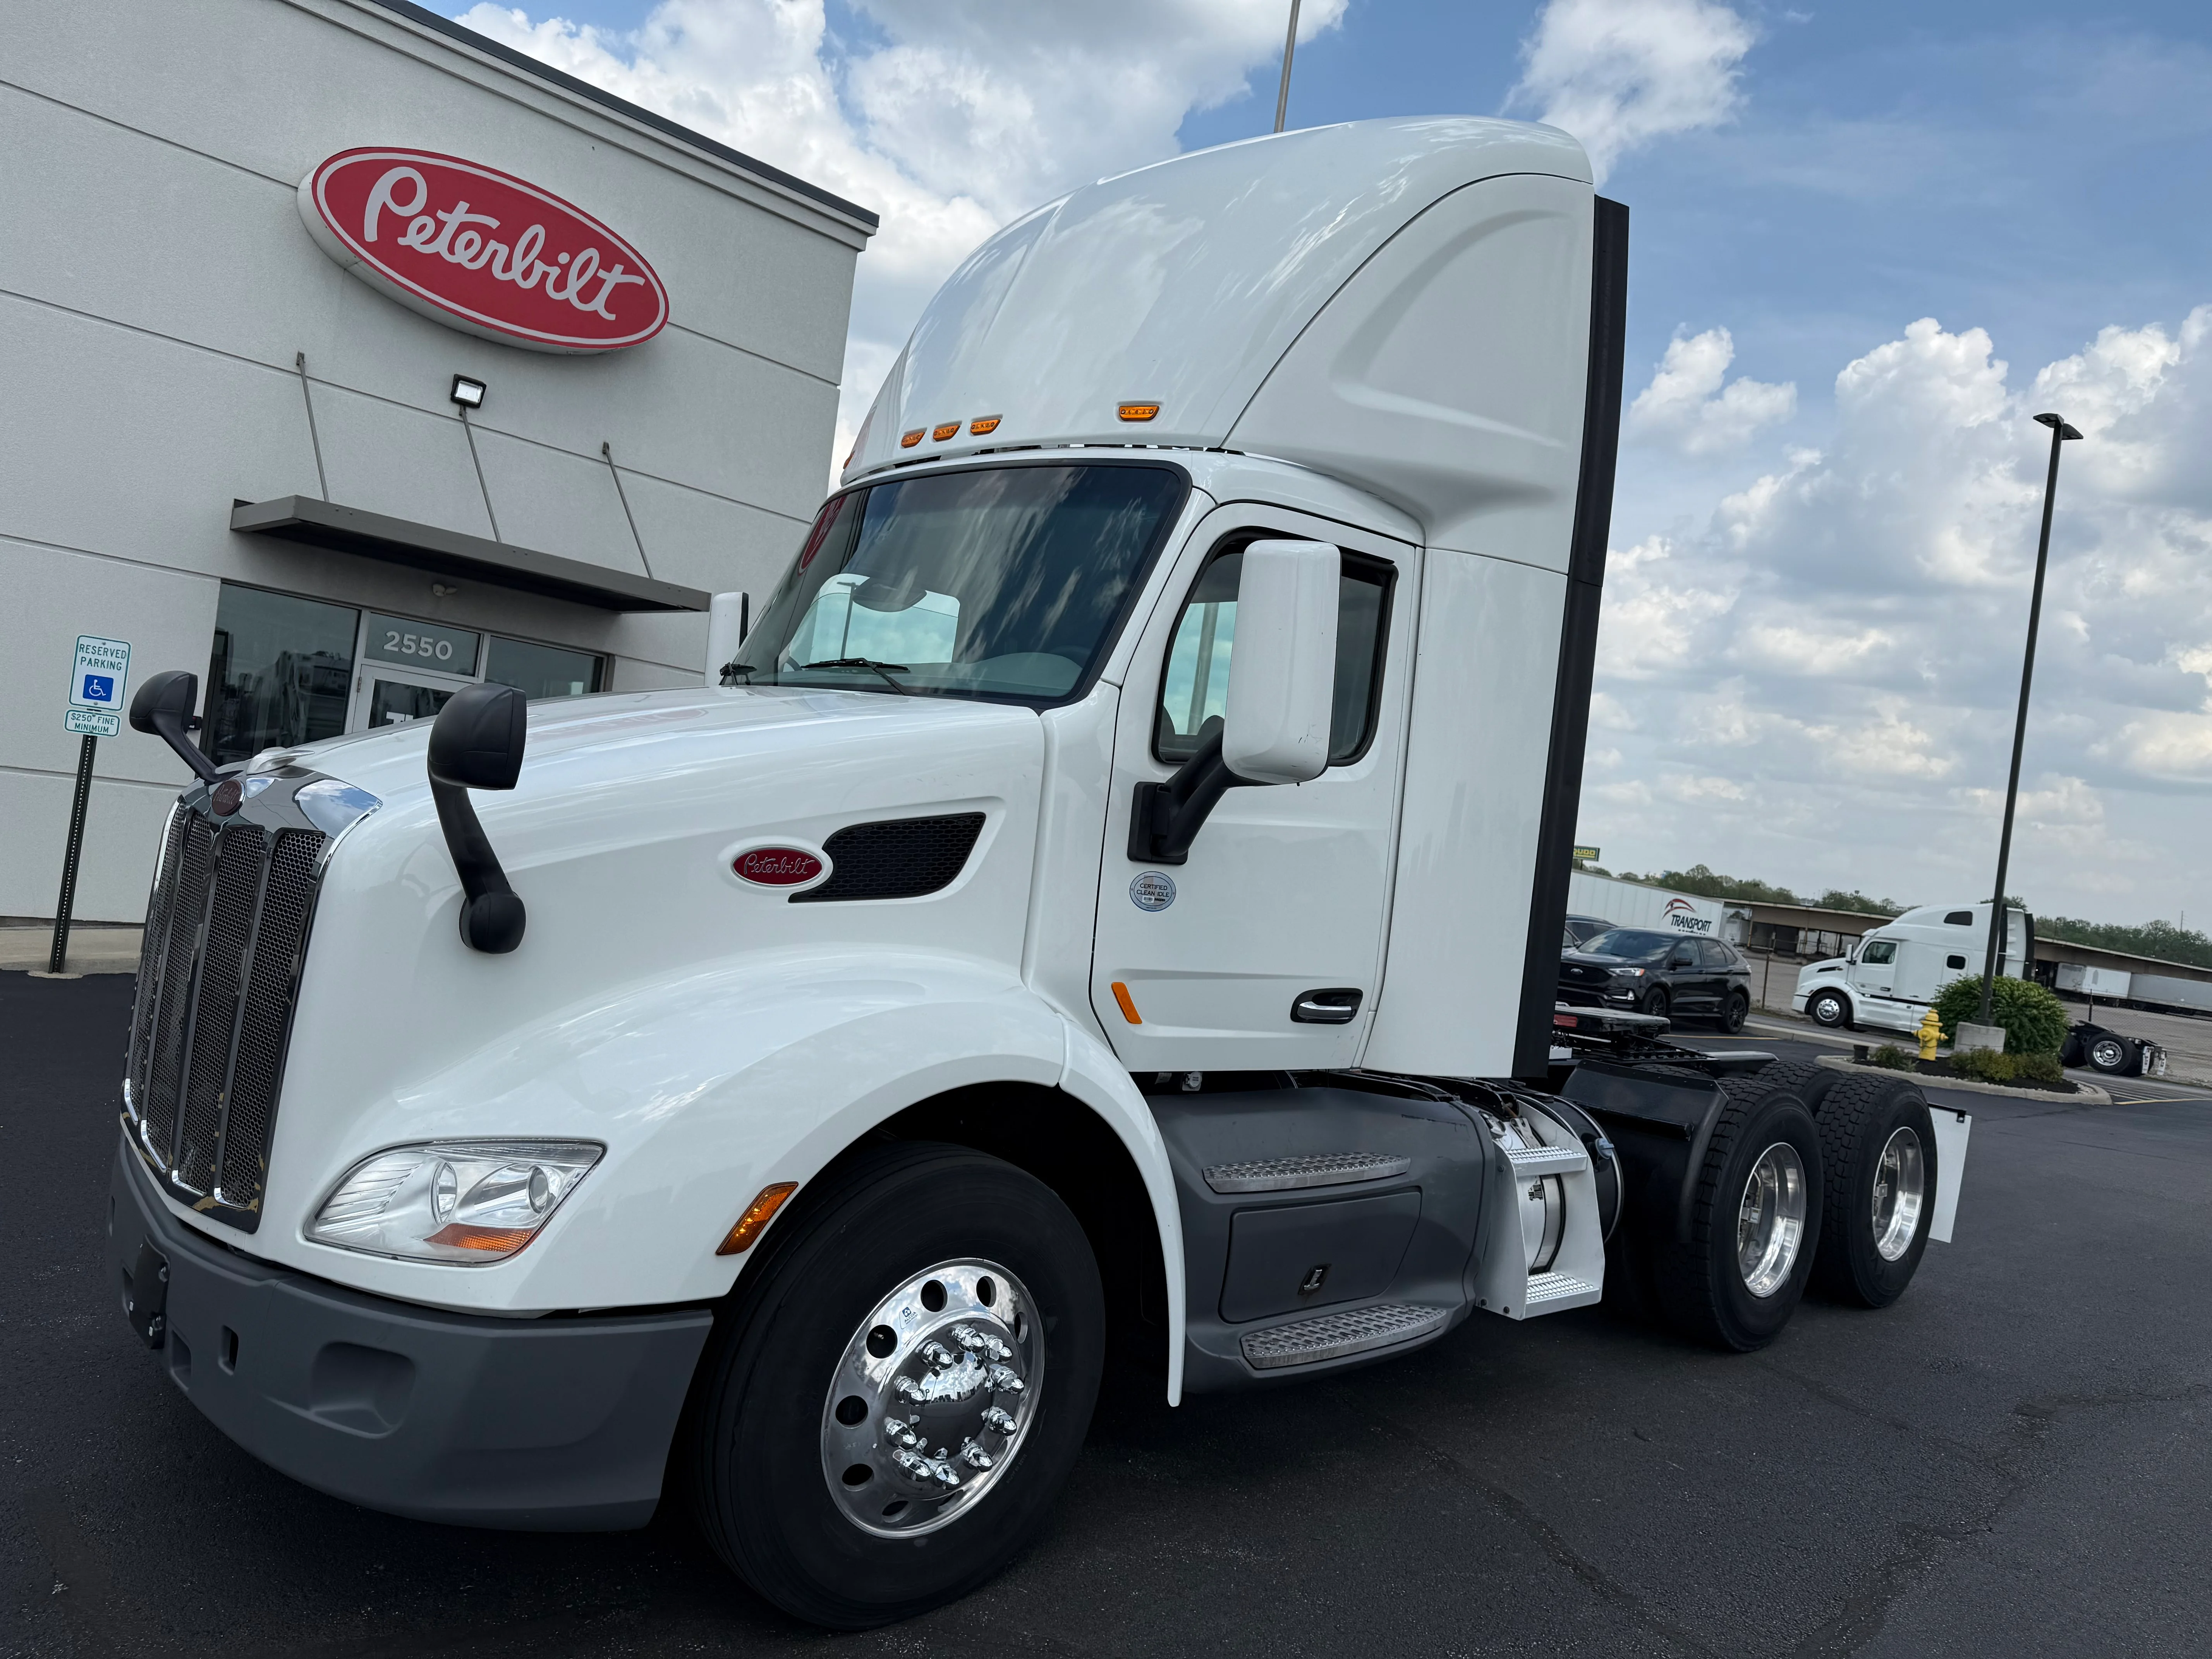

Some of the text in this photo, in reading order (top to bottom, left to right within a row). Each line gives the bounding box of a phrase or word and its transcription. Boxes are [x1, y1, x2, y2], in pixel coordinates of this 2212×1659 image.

[364, 166, 645, 320] Peterbilt
[79, 644, 126, 659] RESERVED
[383, 631, 452, 660] 2550
[80, 656, 122, 671] PARKING
[71, 713, 115, 725] $250 FINE
[74, 723, 109, 733] MINIMUM
[744, 854, 815, 874] Peterbilt
[1671, 914, 1712, 932] TRANSPORT
[905, 1312, 917, 1323] ALCOA
